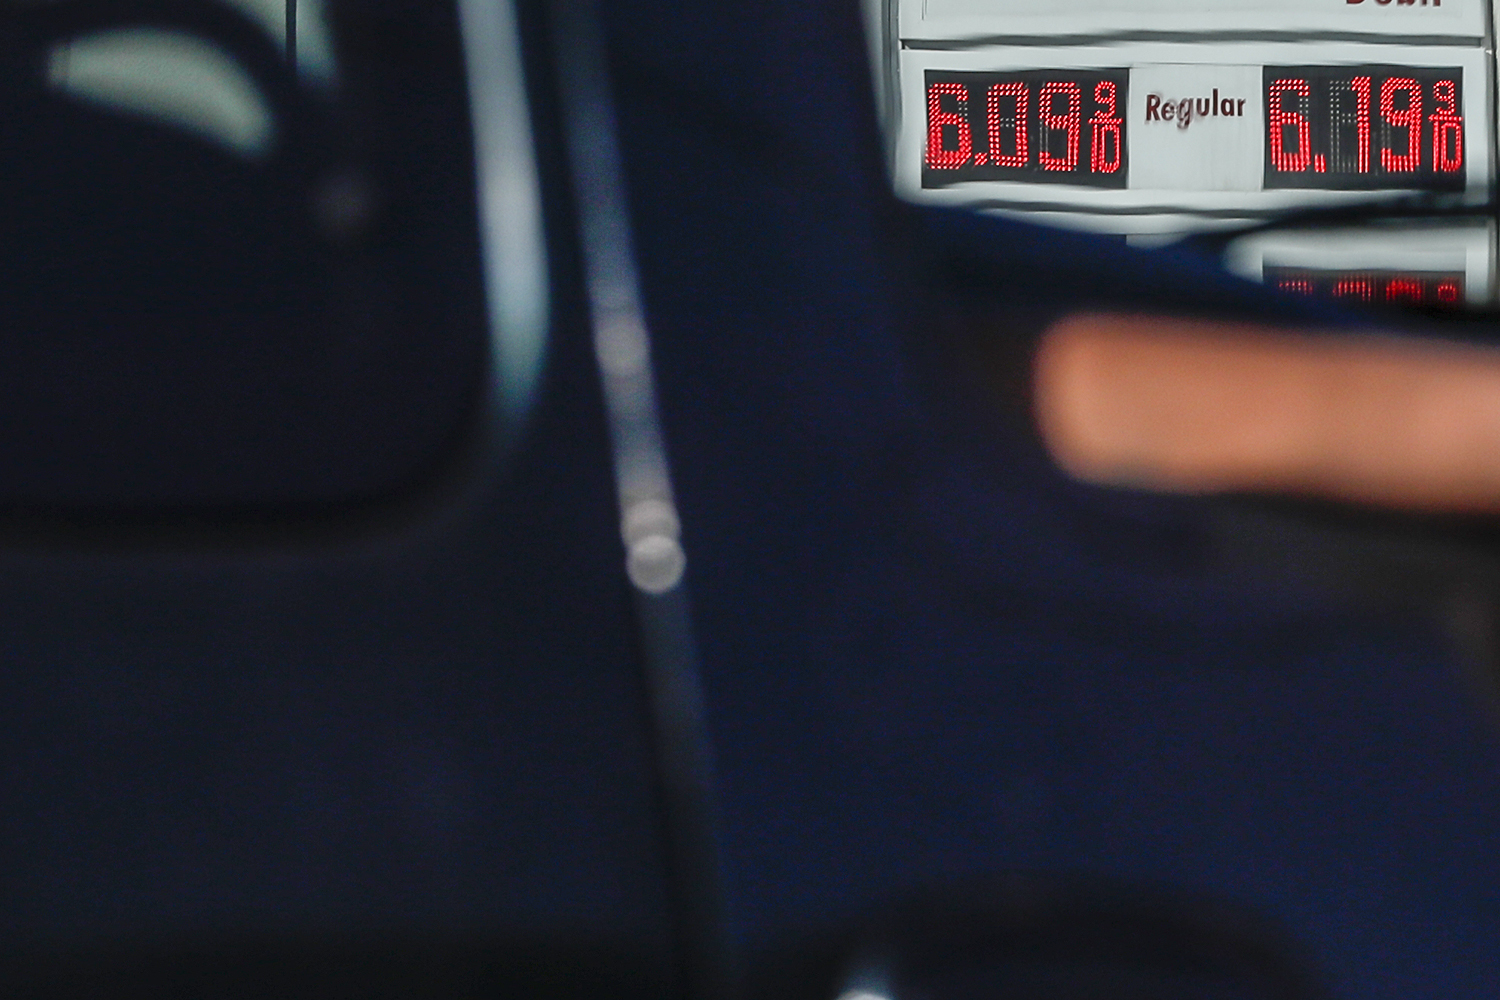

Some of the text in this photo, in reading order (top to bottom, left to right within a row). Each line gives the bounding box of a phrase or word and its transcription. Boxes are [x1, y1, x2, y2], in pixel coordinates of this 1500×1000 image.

[924, 82, 1081, 171] 6.09
[1145, 88, 1245, 129] Regular
[1269, 76, 1422, 173] 6.19
